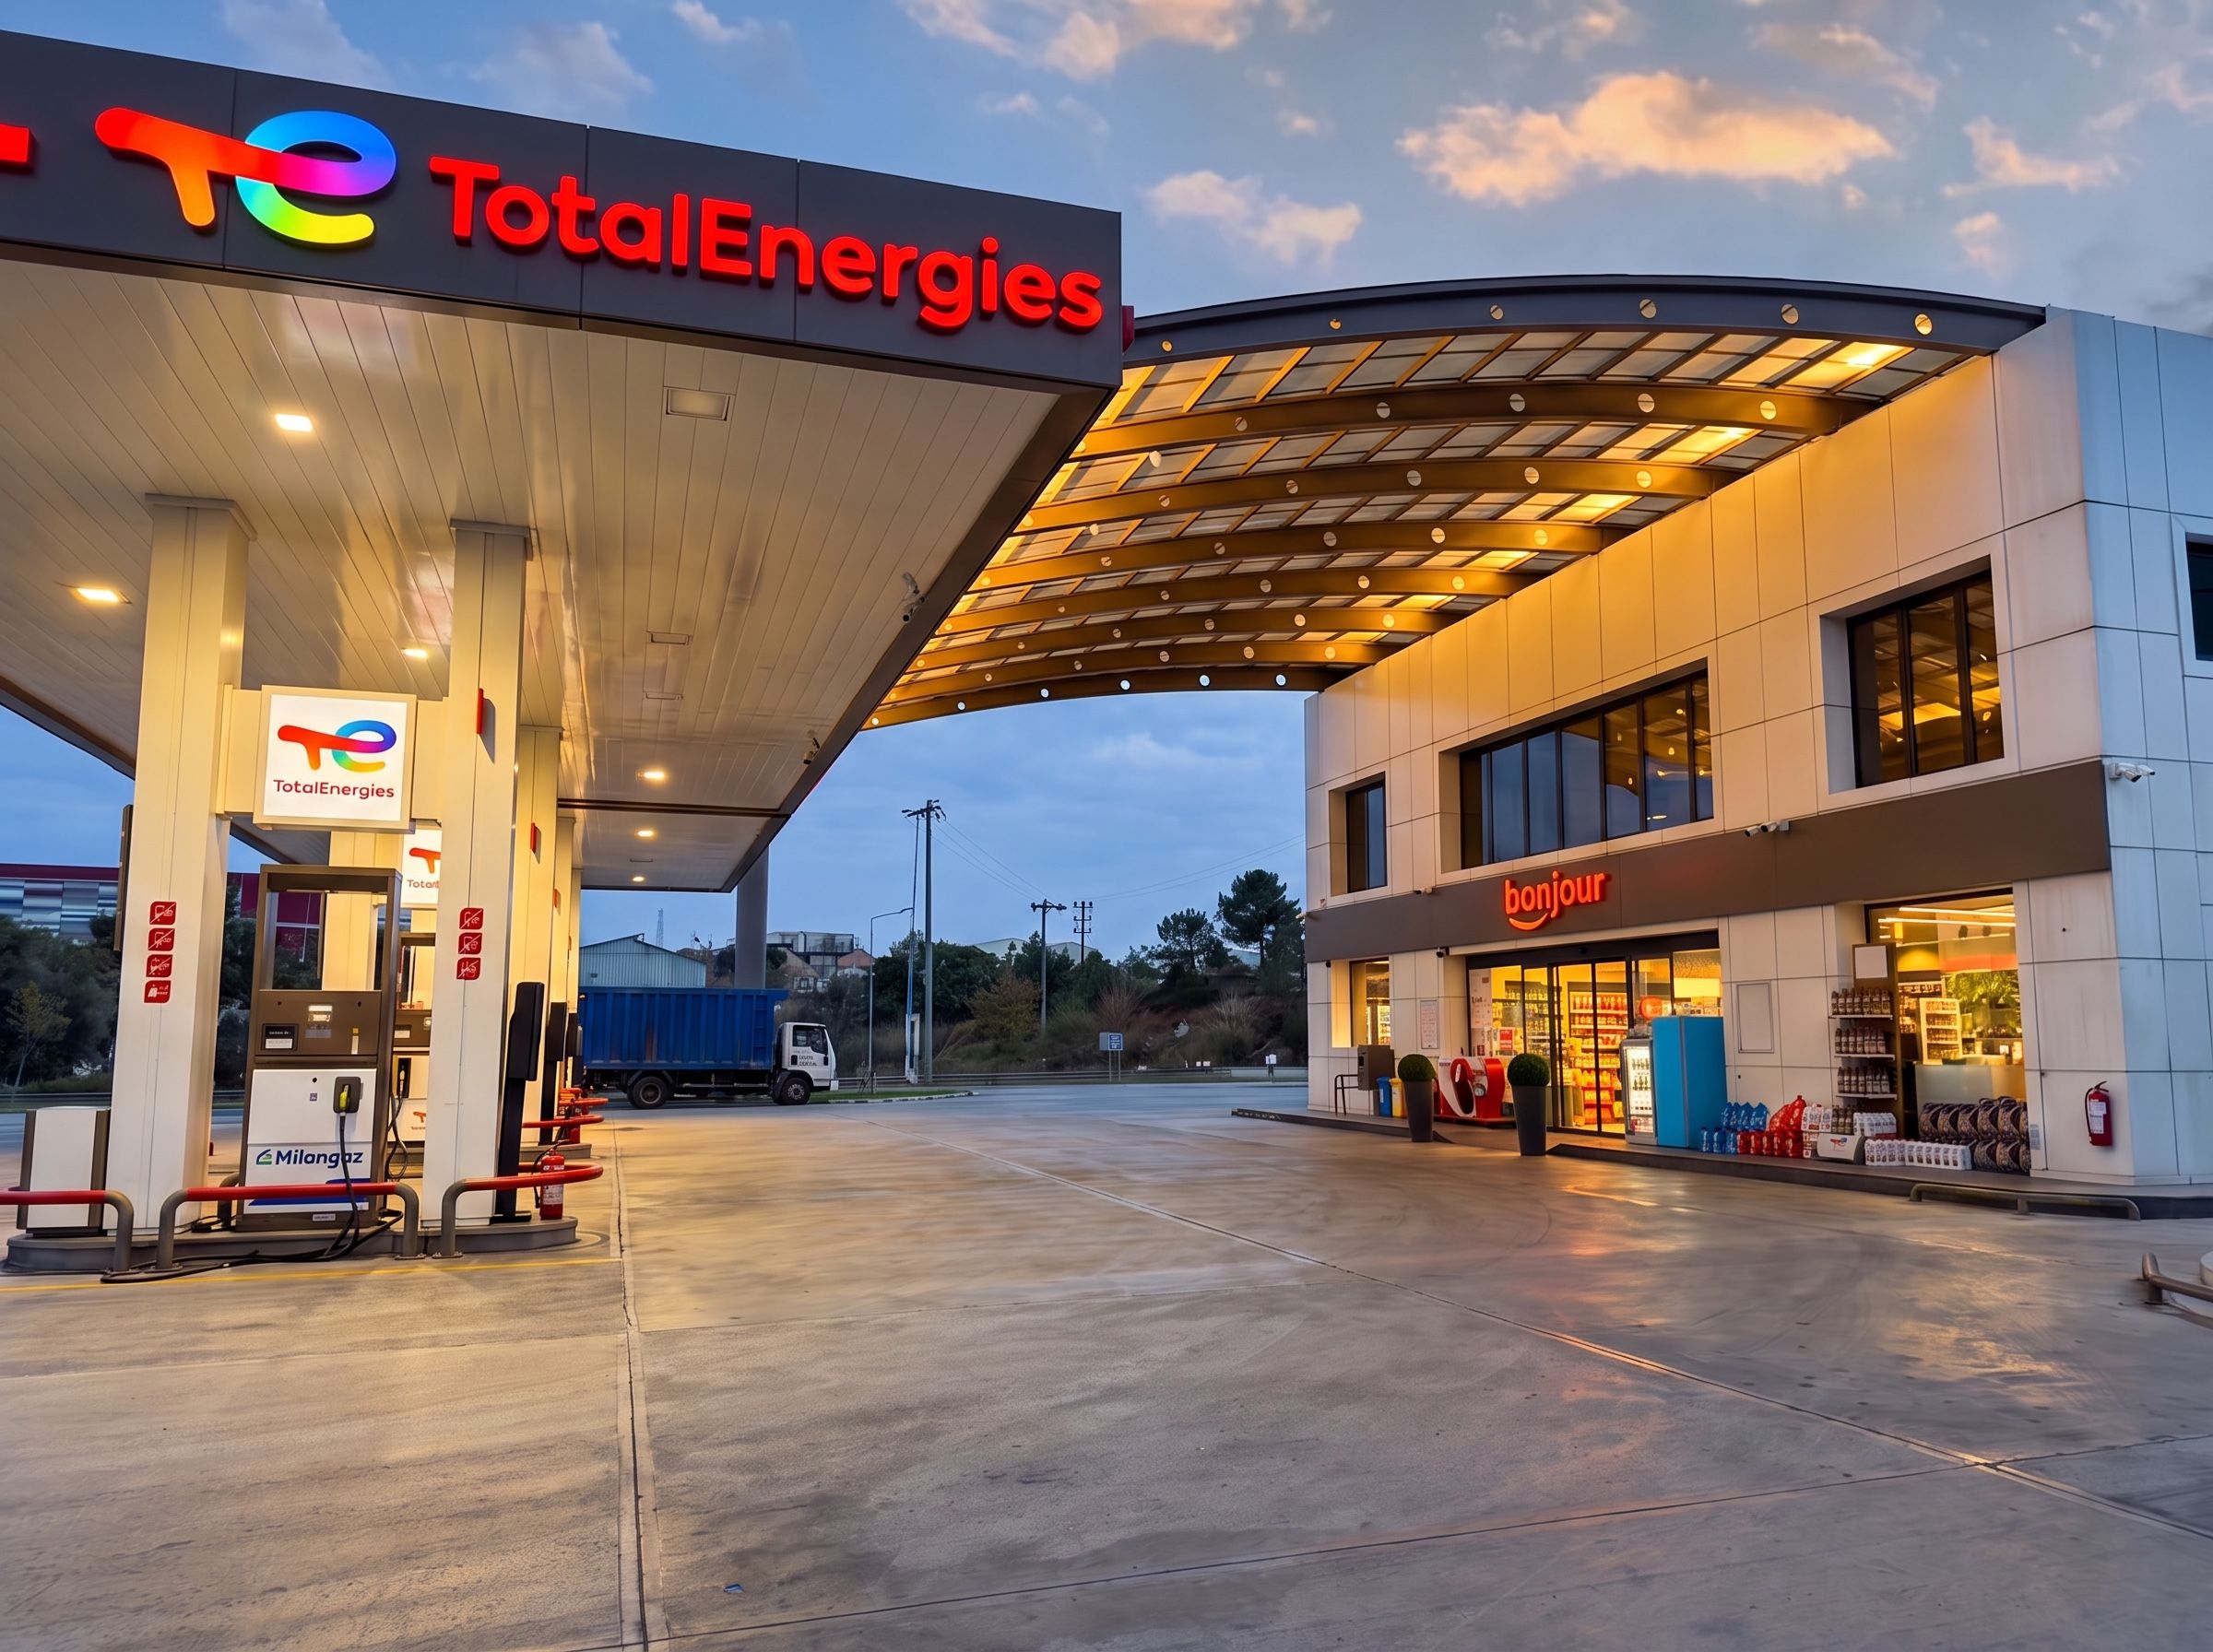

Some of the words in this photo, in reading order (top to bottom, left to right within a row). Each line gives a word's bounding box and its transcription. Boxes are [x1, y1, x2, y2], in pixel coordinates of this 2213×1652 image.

[429, 155, 1104, 331] TotalEnergies
[273, 779, 395, 799] TotalEnergies
[1504, 870, 1606, 918] bonjour
